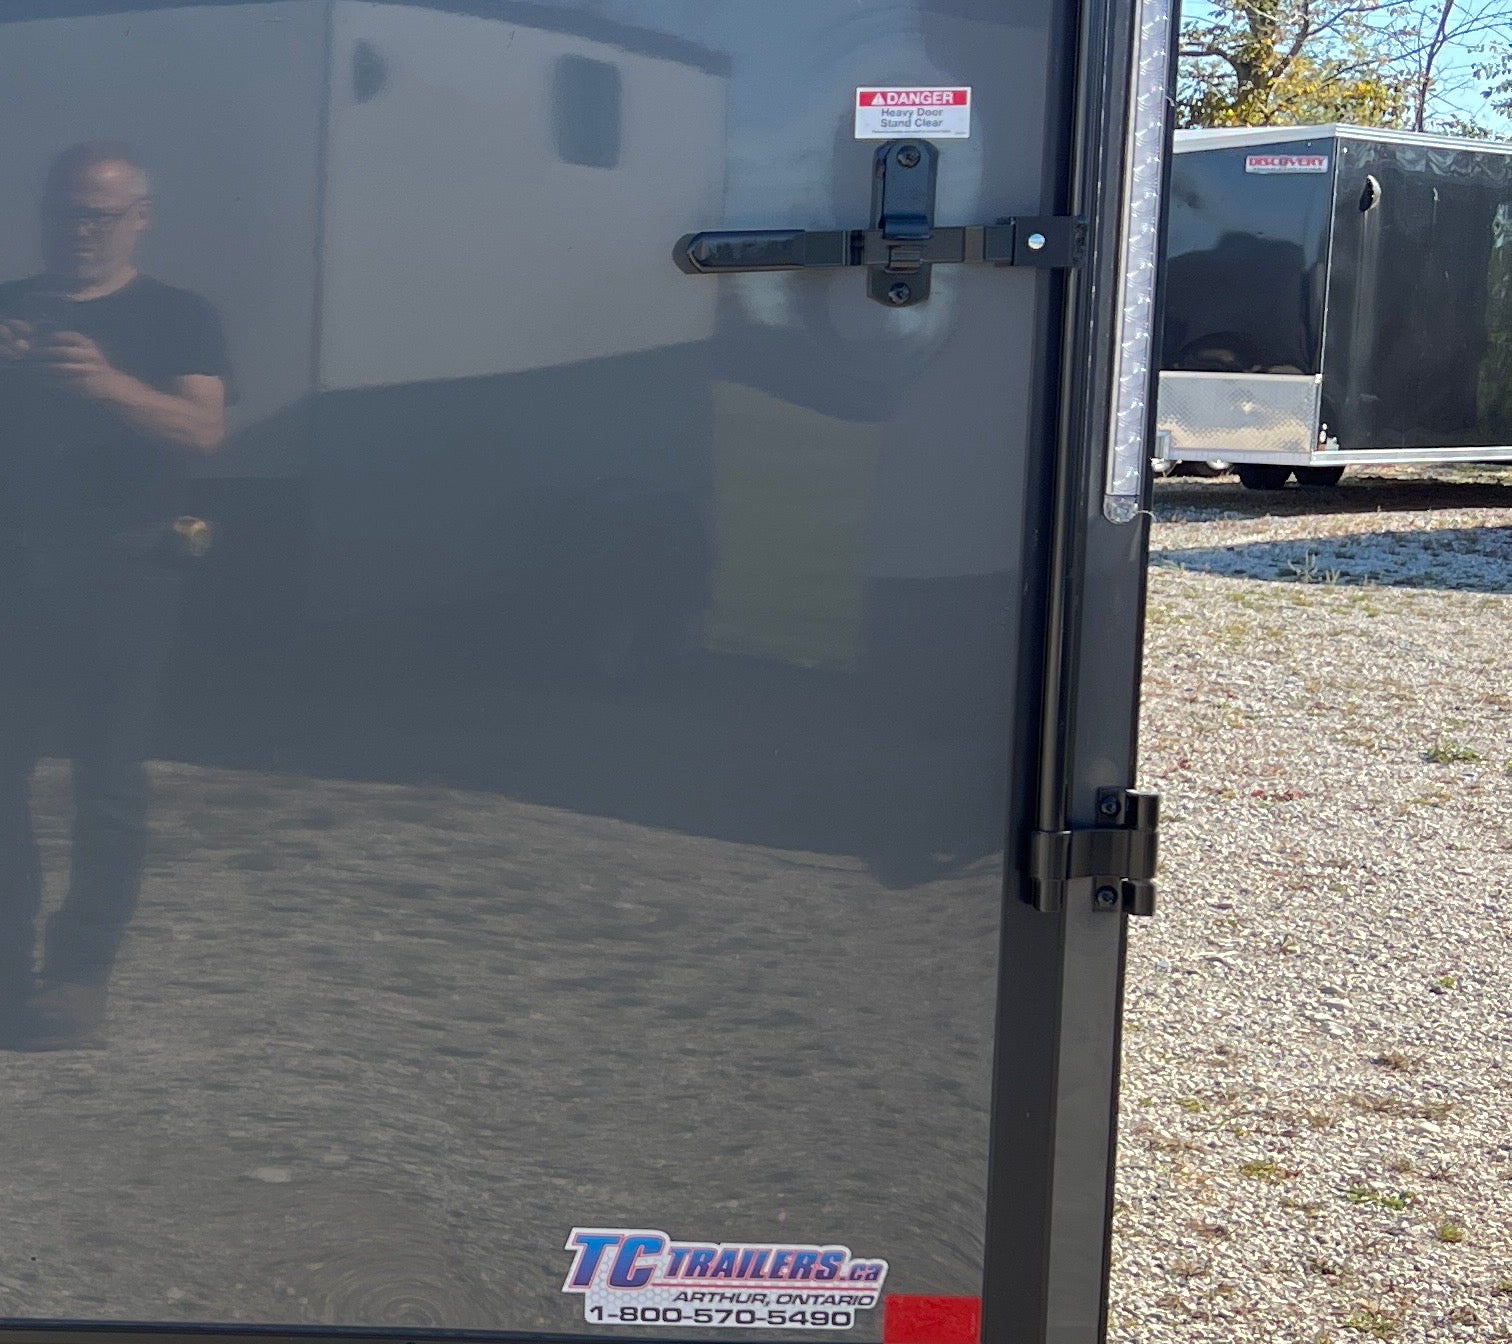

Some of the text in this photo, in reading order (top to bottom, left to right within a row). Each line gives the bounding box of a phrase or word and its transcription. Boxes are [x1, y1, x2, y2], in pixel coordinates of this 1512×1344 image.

[886, 91, 954, 105] DANGER
[881, 107, 944, 118] Heavy Door
[880, 118, 944, 128] Stand Clear
[1249, 157, 1325, 167] DISCOVERY
[569, 1233, 883, 1289] TC TRAILERS.ca
[672, 1291, 875, 1307] ARTHUR, ONTARIO
[589, 1306, 852, 1327] 1-800-570-5490
